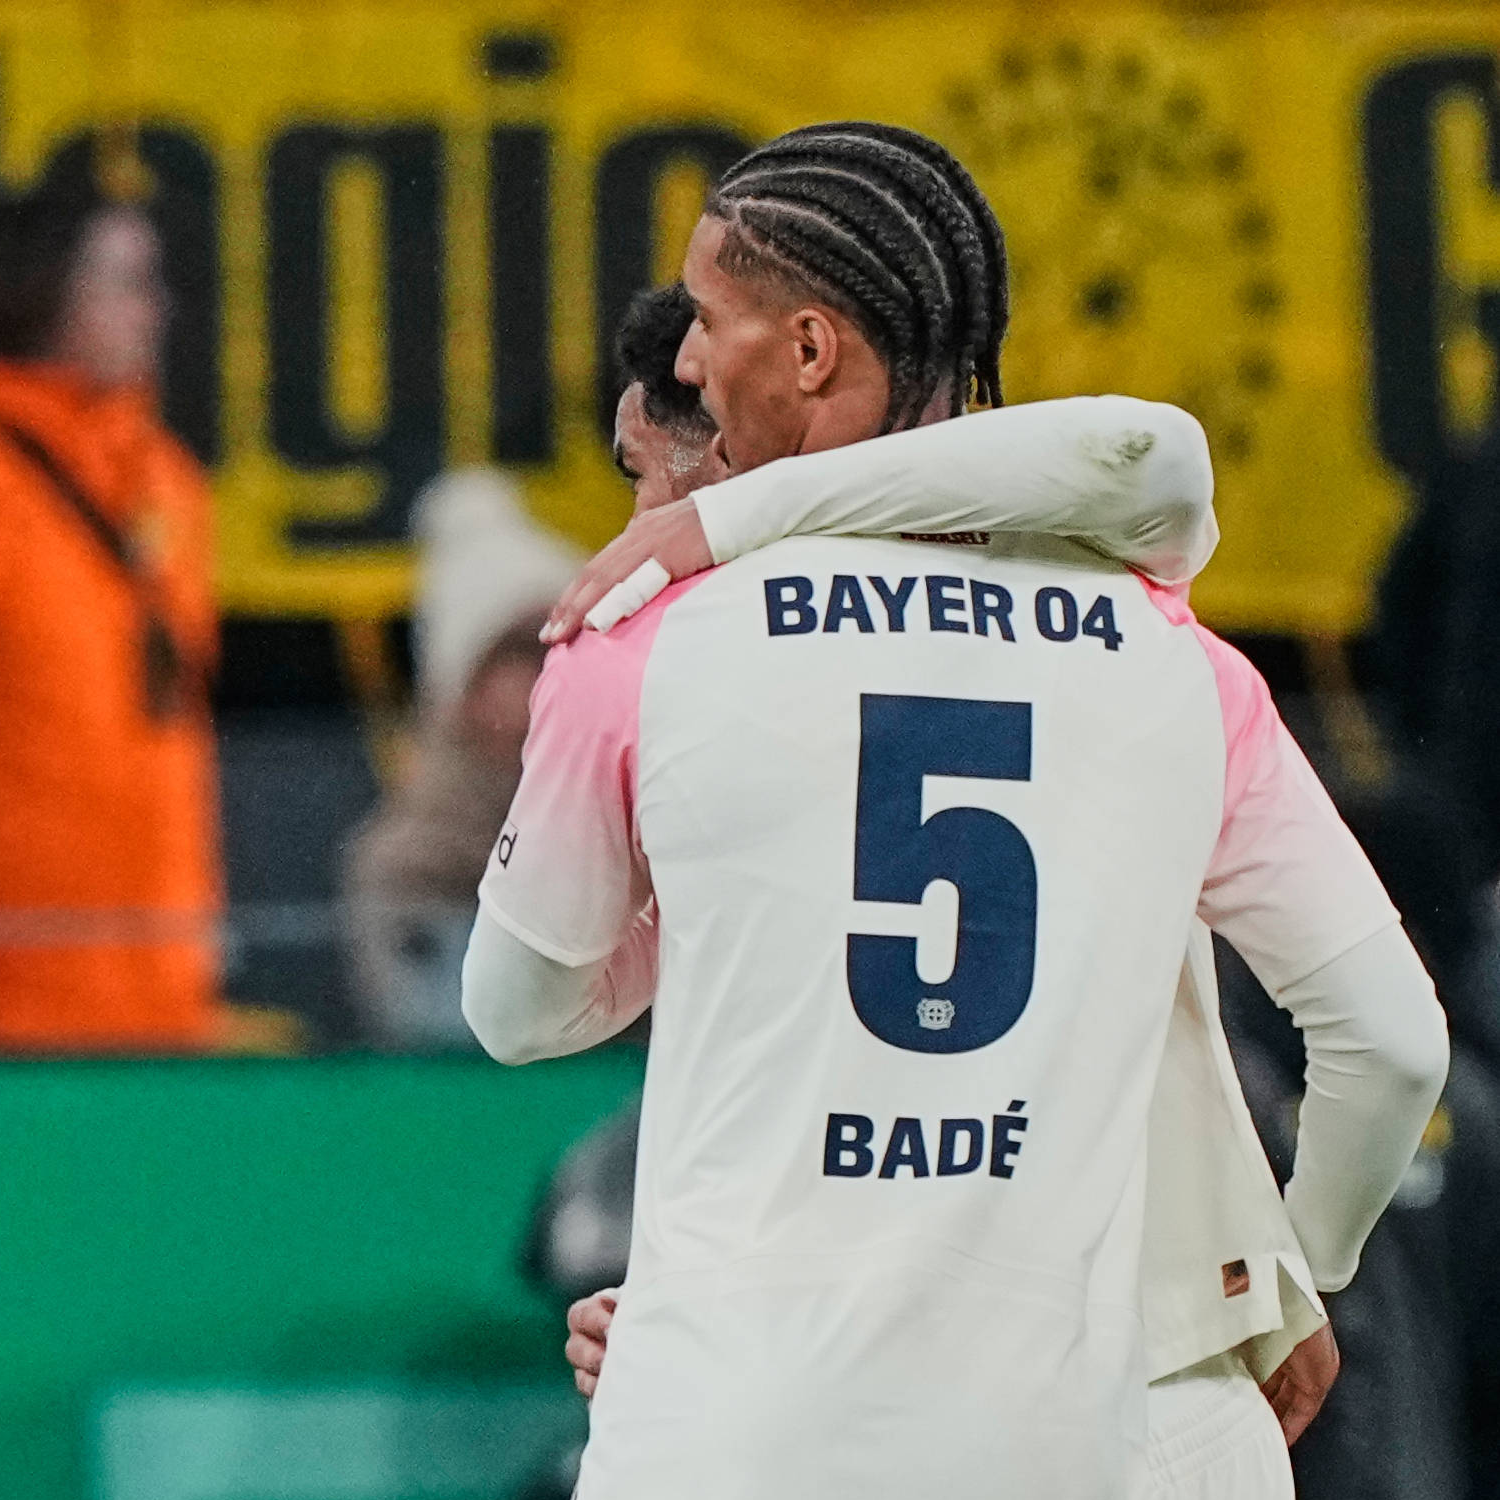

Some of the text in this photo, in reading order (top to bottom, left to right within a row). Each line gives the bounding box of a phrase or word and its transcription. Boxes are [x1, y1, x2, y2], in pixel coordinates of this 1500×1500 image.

[762, 574, 1124, 651] BAYER 04
[846, 693, 1038, 1054] 5
[822, 1100, 1029, 1180] BADÉ
